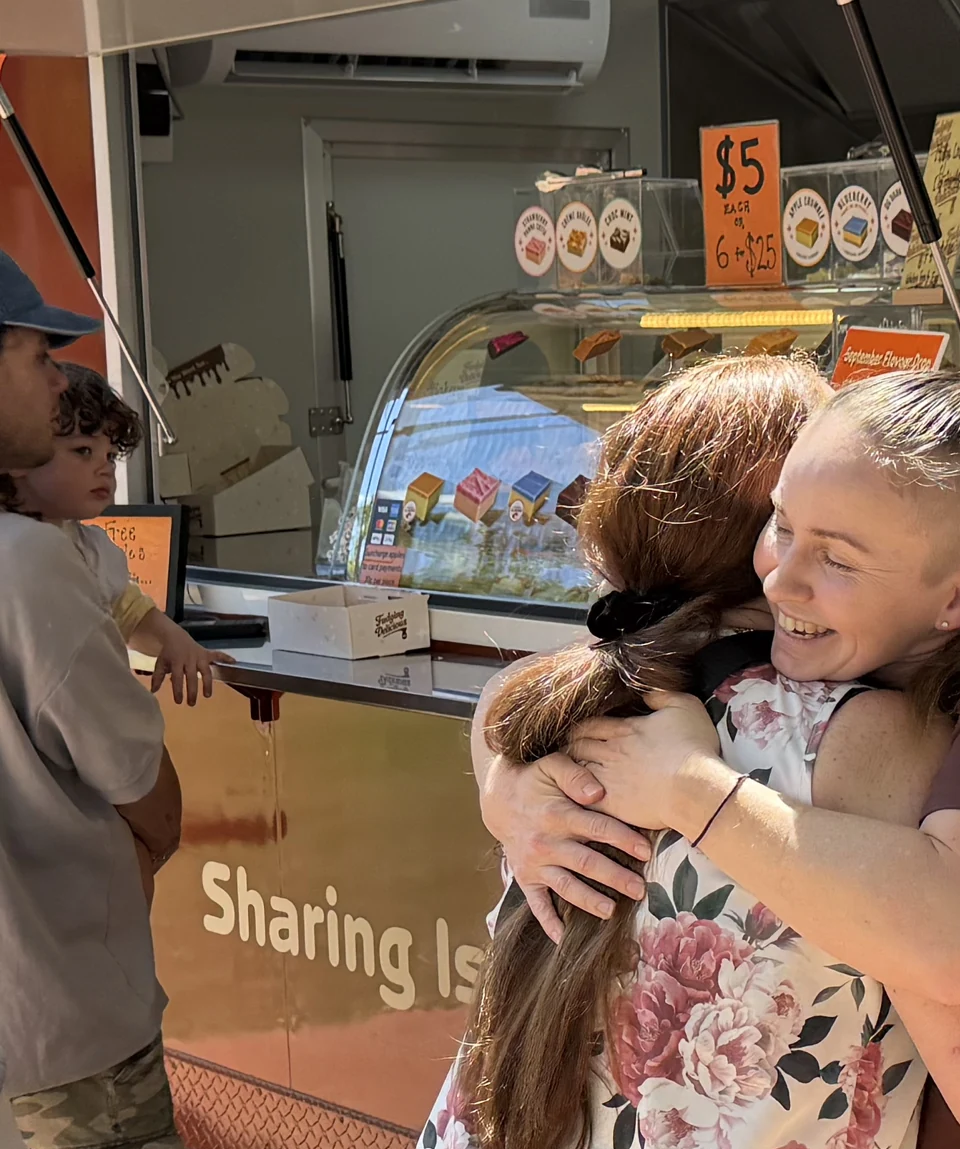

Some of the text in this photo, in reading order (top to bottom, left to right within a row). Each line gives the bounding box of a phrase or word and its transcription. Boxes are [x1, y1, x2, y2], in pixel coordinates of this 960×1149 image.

[716, 135, 765, 199] $5
[724, 200, 750, 215] EACH
[789, 196, 802, 219] APPLE
[837, 190, 872, 210] BLUEBERRY
[604, 208, 634, 226] CHOC MINT
[716, 235, 729, 269] 6
[745, 232, 776, 278] $25
[843, 346, 883, 367] September
[374, 618, 408, 638] Delicious
[375, 610, 405, 627] Fudging
[202, 861, 416, 1010] Sharing
